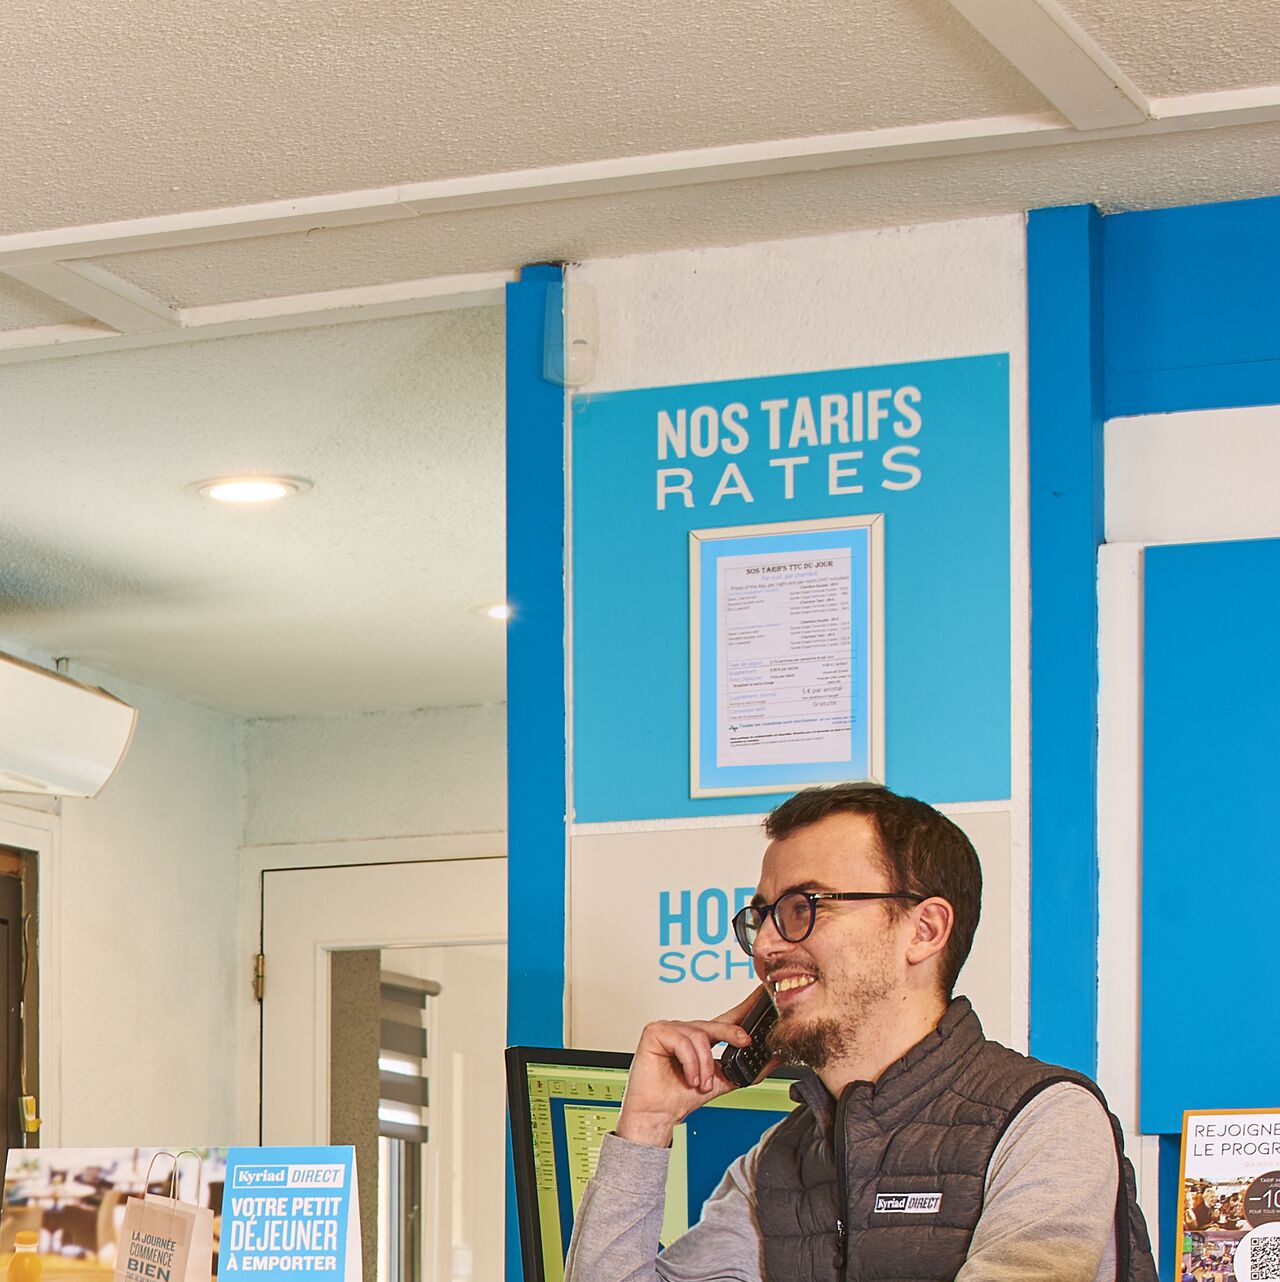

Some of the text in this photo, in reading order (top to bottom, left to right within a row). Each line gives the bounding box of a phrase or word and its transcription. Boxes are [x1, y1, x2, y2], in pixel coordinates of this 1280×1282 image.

[658, 386, 922, 460] NOS TARIFS
[657, 445, 922, 510] RATES
[746, 567, 760, 575] NOS
[762, 565, 787, 573] TARIFS
[789, 563, 802, 571] TTC
[816, 560, 834, 568] JOUR
[659, 949, 755, 984] SCH
[1194, 1122, 1280, 1138] REJOIGNE
[1193, 1141, 1280, 1157] LE PROGR
[239, 1168, 341, 1186] Kyriad DIRECT
[231, 1196, 342, 1217] VOTRE PETIT
[878, 1197, 940, 1211] Kyriad DIRECT
[1249, 1188, 1280, 1208] -10
[132, 1231, 177, 1252] LA JOURNÉE
[230, 1214, 337, 1251] DÉJEUNER
[129, 1242, 174, 1268] COMMENCE
[226, 1253, 337, 1271] À EMPORTER
[127, 1257, 170, 1282] BIEN
